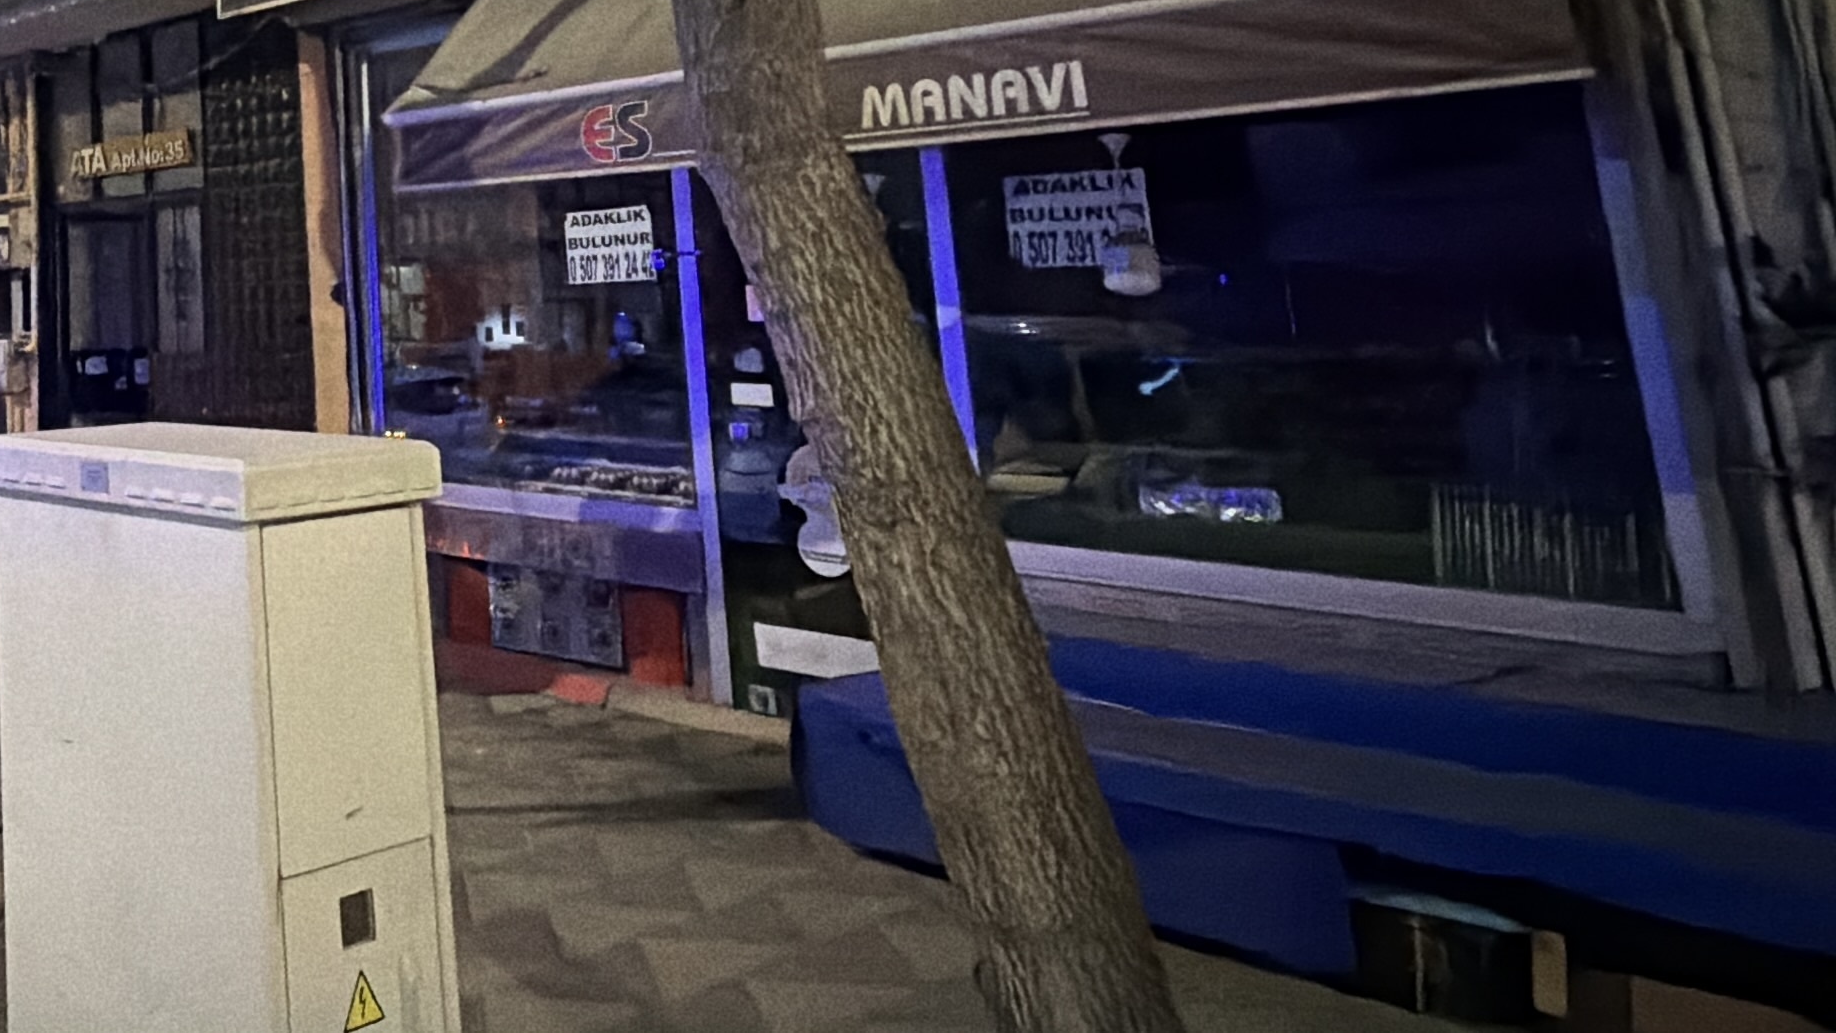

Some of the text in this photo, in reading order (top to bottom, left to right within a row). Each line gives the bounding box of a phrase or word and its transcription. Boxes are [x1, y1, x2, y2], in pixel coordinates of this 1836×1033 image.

[579, 59, 1089, 162] ES MANAVI
[70, 143, 107, 175] ATA
[570, 209, 646, 227] ADAKLIK
[568, 232, 652, 250] BULUNUR
[1028, 230, 1057, 265] 507
[1065, 229, 1096, 263] 391
[569, 255, 577, 282] 0
[580, 253, 598, 282] 507
[601, 252, 621, 280] 391
[624, 251, 639, 279] 24
